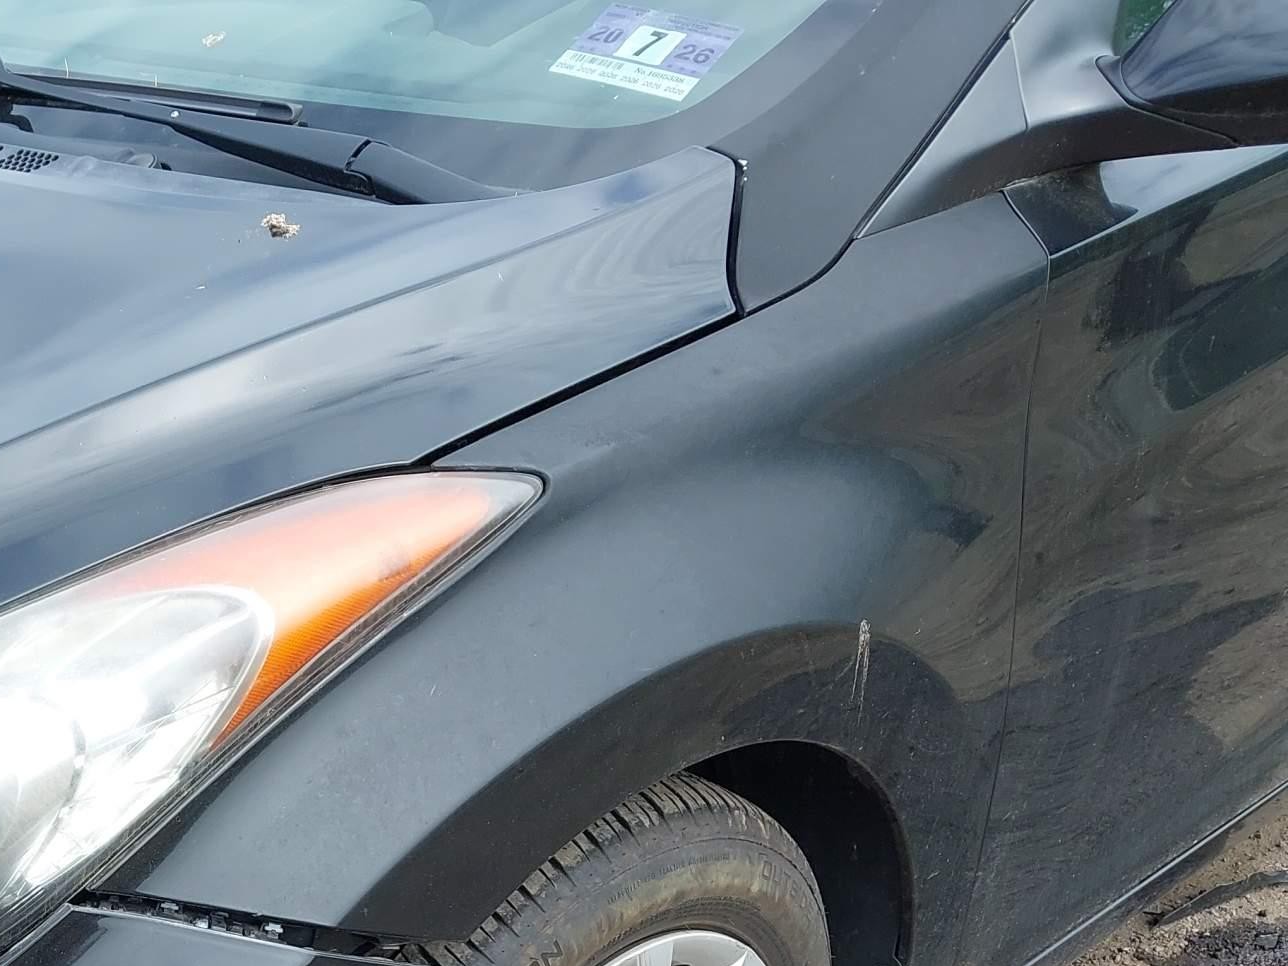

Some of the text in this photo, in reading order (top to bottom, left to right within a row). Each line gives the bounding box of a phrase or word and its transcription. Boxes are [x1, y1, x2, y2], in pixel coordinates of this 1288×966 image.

[588, 25, 715, 65] 20 7 26
